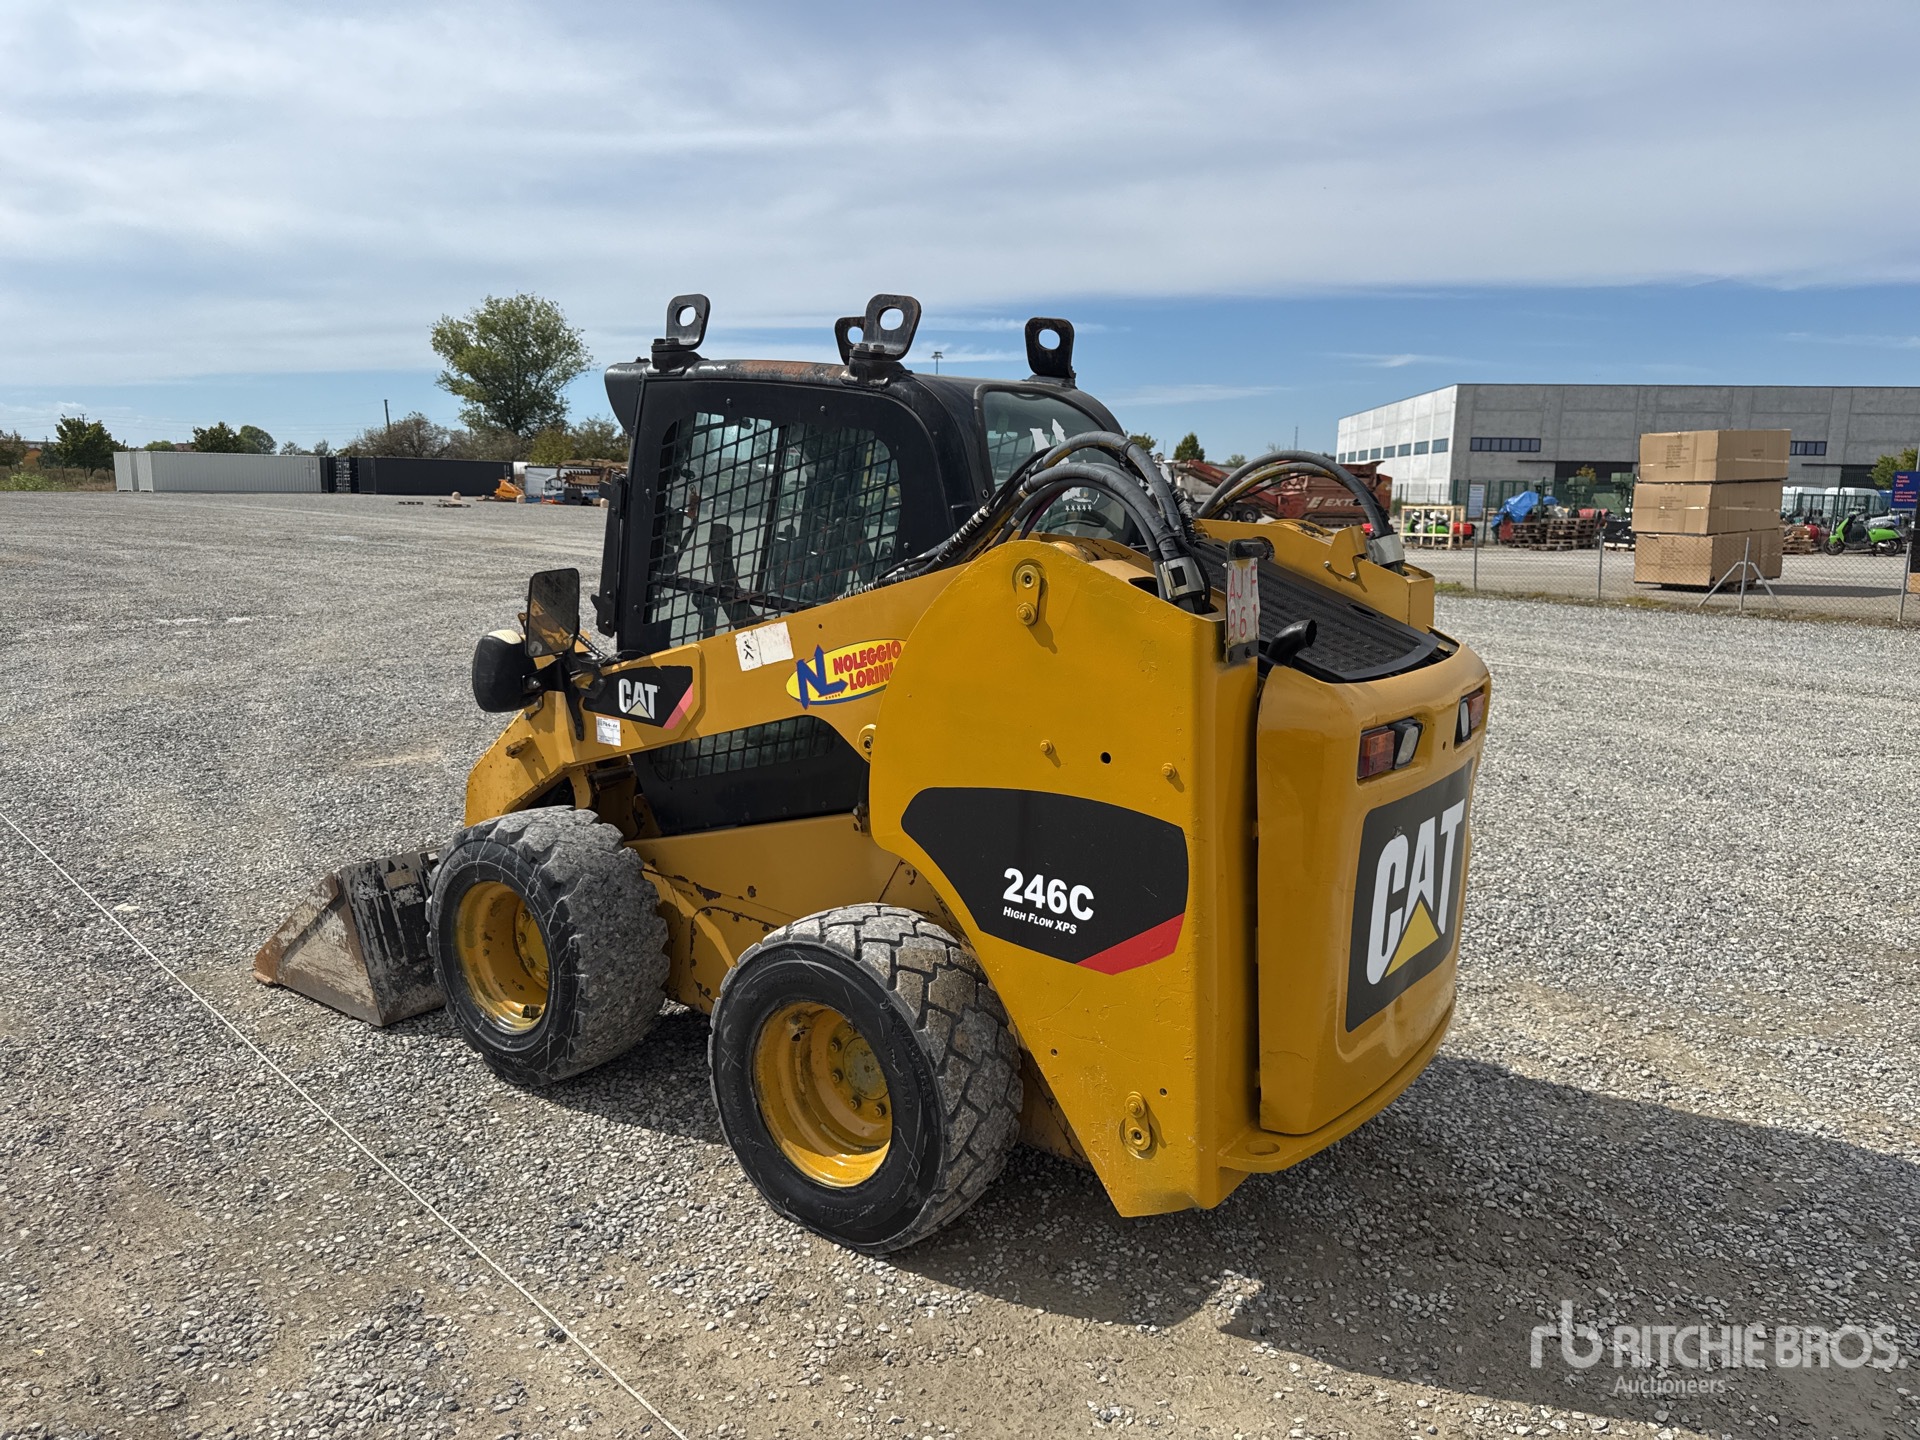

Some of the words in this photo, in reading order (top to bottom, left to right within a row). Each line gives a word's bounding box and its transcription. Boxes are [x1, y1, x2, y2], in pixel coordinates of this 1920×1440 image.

[1324, 498, 1358, 507] EXT
[1229, 603, 1258, 641] 961
[833, 640, 902, 675] NOLEGGIO
[618, 678, 658, 719] CAT
[1003, 867, 1095, 921] 246C
[1366, 798, 1465, 985] CAT
[1055, 920, 1077, 934] XPS
